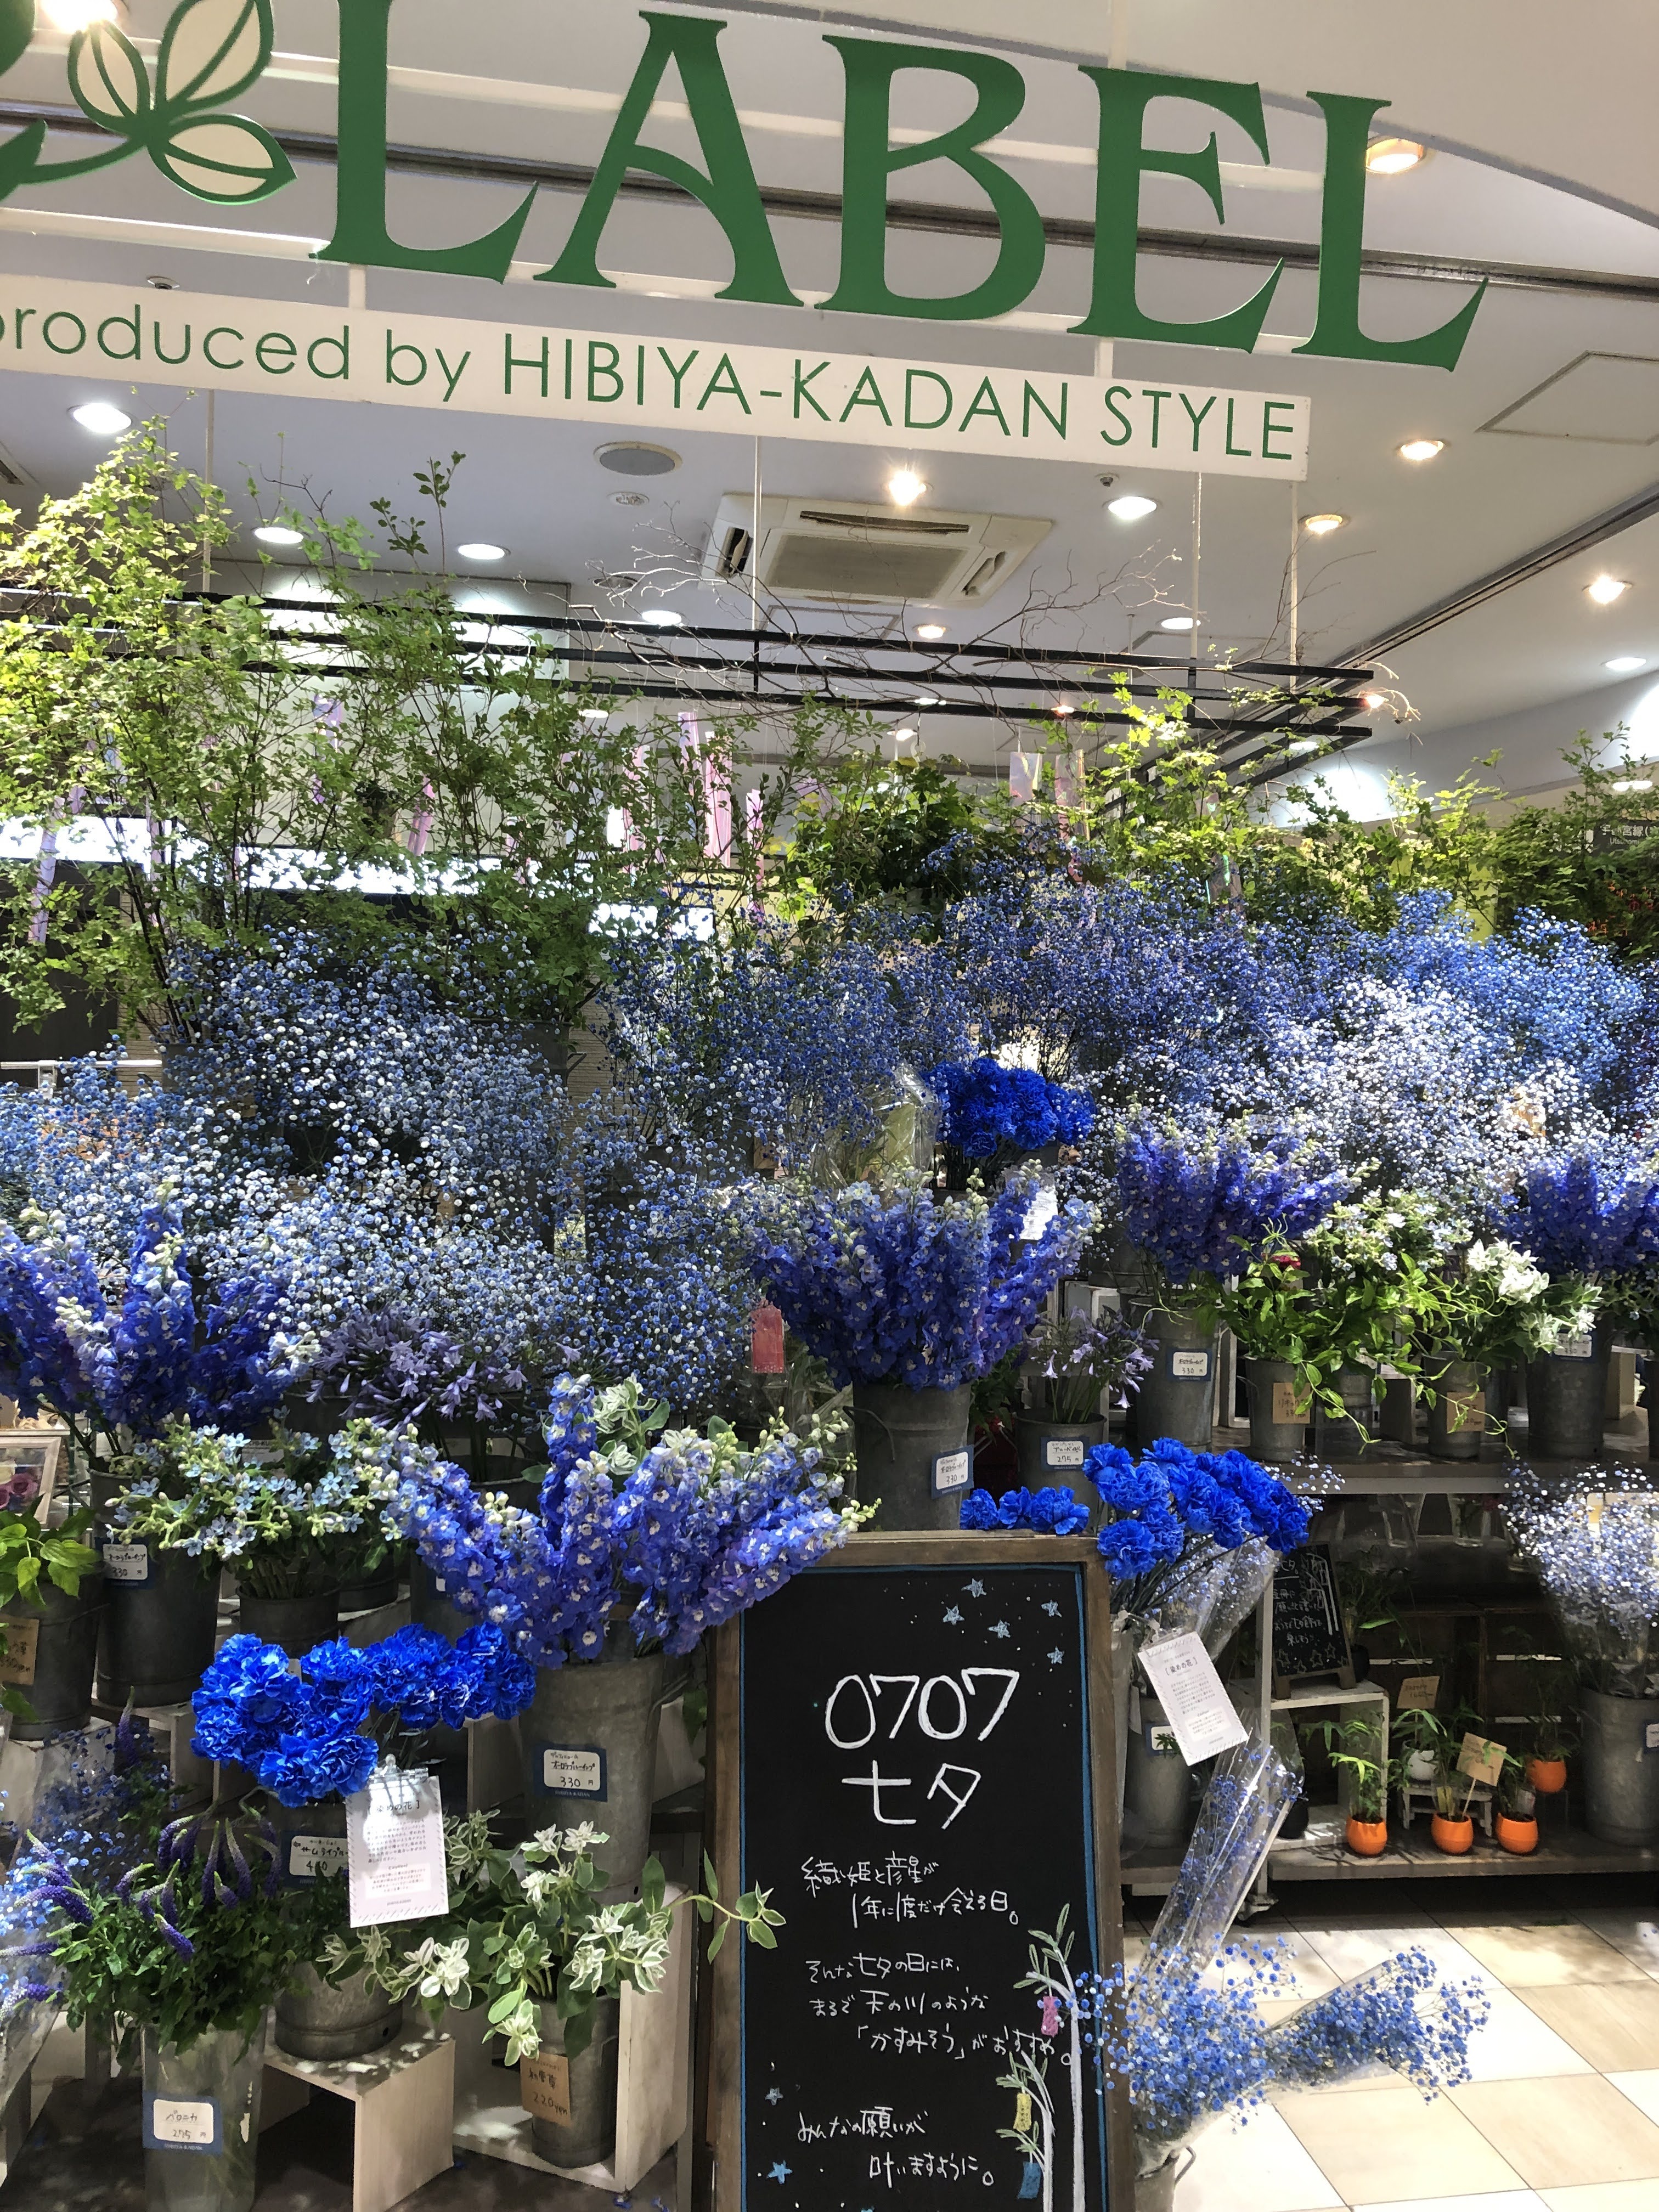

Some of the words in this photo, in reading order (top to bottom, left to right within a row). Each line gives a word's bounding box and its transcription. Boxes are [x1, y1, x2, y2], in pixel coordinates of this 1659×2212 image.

[309, 0, 1488, 373] LABEL
[0, 303, 351, 382] roduced
[386, 329, 471, 403] by
[504, 332, 1069, 441] HIBIYA-KADAN
[1101, 385, 1296, 460] STYLE
[946, 1474, 957, 1485] 330
[825, 1667, 1020, 1750] 0707
[560, 1776, 581, 1787] 330
[842, 1760, 981, 1830] 七夕
[306, 1860, 328, 1872] 40
[165, 2110, 198, 2122] ベロニカ
[798, 2106, 929, 2143] みんなの願いが
[173, 2129, 192, 2140] 275
